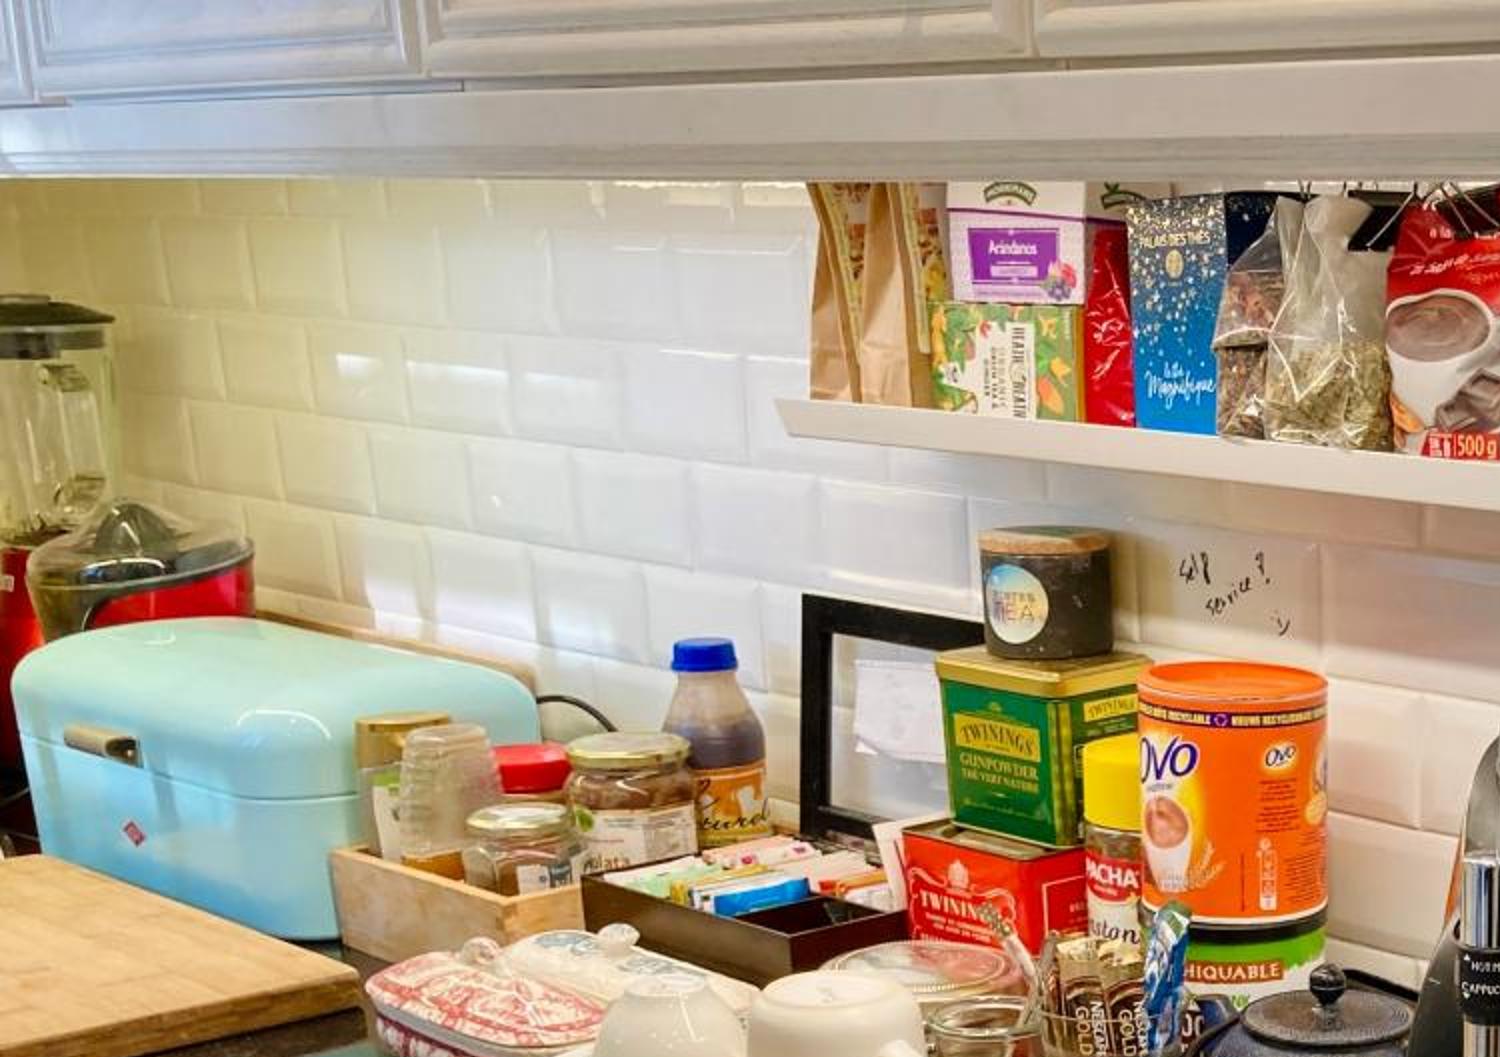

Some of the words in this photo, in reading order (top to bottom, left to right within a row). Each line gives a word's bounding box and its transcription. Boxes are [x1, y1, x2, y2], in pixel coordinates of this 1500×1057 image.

[1457, 434, 1486, 457] 500
[1487, 439, 1497, 460] g
[960, 721, 1036, 756] TWININGS
[959, 752, 1039, 782] GUNPOWDER
[1076, 1006, 1094, 1056] GOLD
[1119, 1009, 1137, 1057] GOLD
